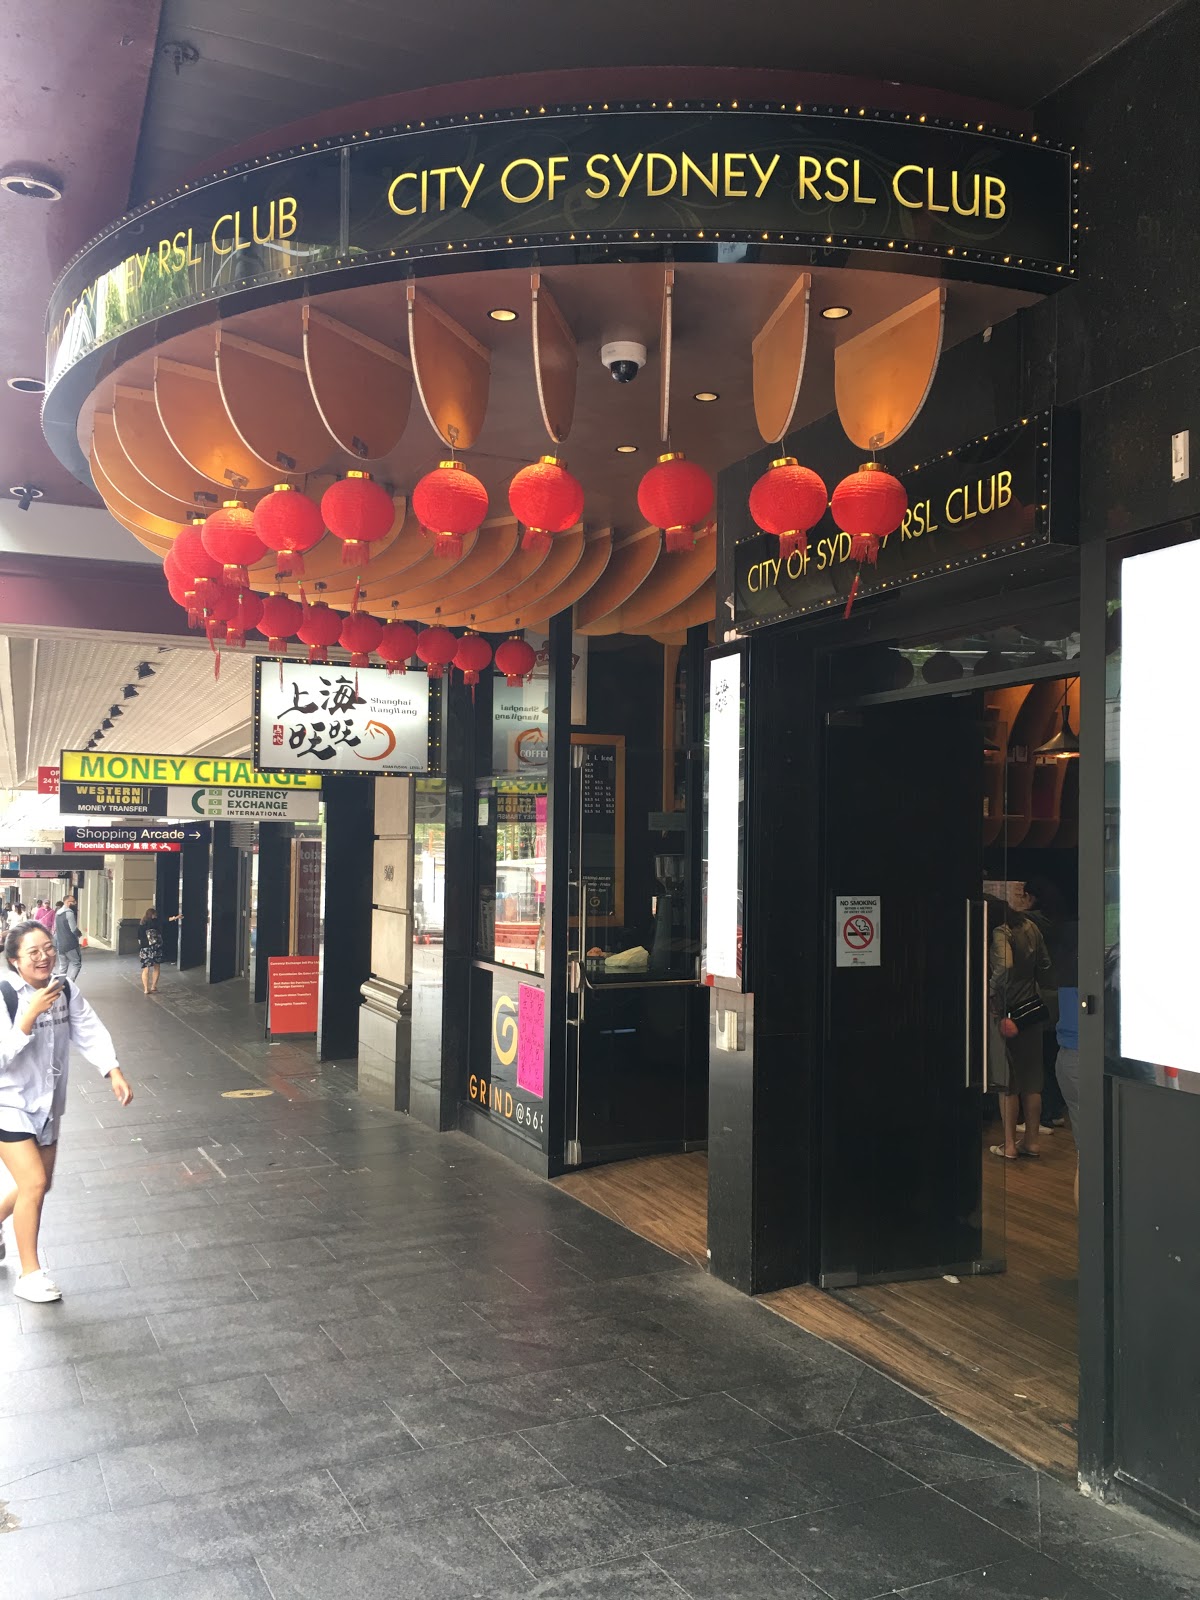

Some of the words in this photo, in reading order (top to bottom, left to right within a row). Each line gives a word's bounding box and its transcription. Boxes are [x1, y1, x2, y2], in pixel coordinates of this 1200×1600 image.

[387, 162, 486, 216] CITY
[500, 156, 570, 204] OF
[584, 151, 781, 200] SYDNEY
[799, 155, 877, 205] RSL
[892, 164, 1007, 220] CLUB
[80, 246, 151, 318] SYEY
[158, 228, 202, 278] RSL
[211, 196, 298, 255] CLUB
[747, 558, 782, 593] CITY
[787, 544, 812, 579] OF
[816, 530, 890, 571] SYD
[901, 499, 939, 542] RSL
[945, 470, 1013, 524] CLUB
[277, 675, 367, 720] 上海
[370, 697, 411, 707] Shanghai
[289, 718, 361, 761] 旺旺
[520, 749, 549, 758] COFFE
[80, 756, 187, 780] MONEY
[194, 760, 307, 786] CHANGE
[76, 786, 141, 796] WESTERN
[227, 790, 289, 800] CURRENCY
[96, 795, 141, 805] UNION
[227, 800, 288, 810] EXCHANGE
[77, 804, 107, 812] MONEY
[109, 805, 148, 813] TRANSFER
[76, 828, 137, 841] Shopping
[140, 829, 185, 840] Arcade
[105, 842, 131, 851] Beauty
[469, 1074, 513, 1119] GRIND
